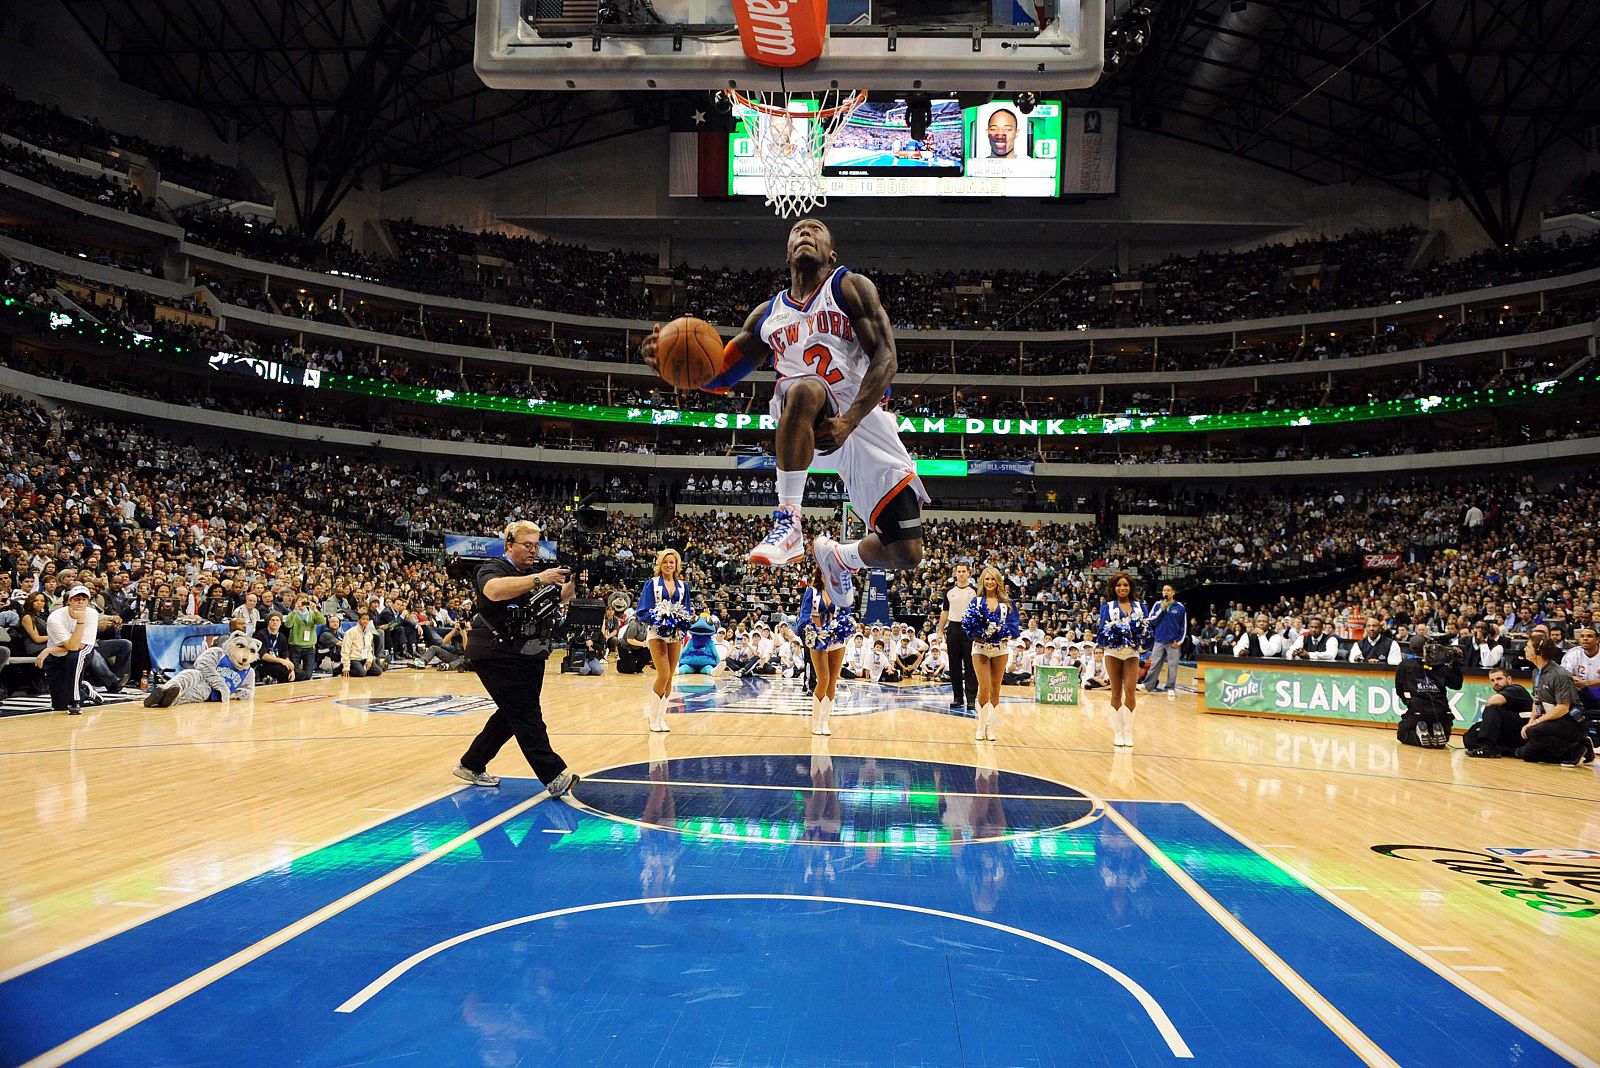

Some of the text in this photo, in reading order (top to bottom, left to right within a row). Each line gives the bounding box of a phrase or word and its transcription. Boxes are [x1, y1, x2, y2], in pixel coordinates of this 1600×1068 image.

[746, 0, 796, 56] arm
[803, 344, 844, 385] 2
[966, 419, 1065, 435] DUNK
[1047, 693, 1073, 702] DUNK
[1054, 686, 1073, 694] SLAM
[1223, 681, 1259, 703] Sprite
[1275, 680, 1465, 721] SLAM DUK
